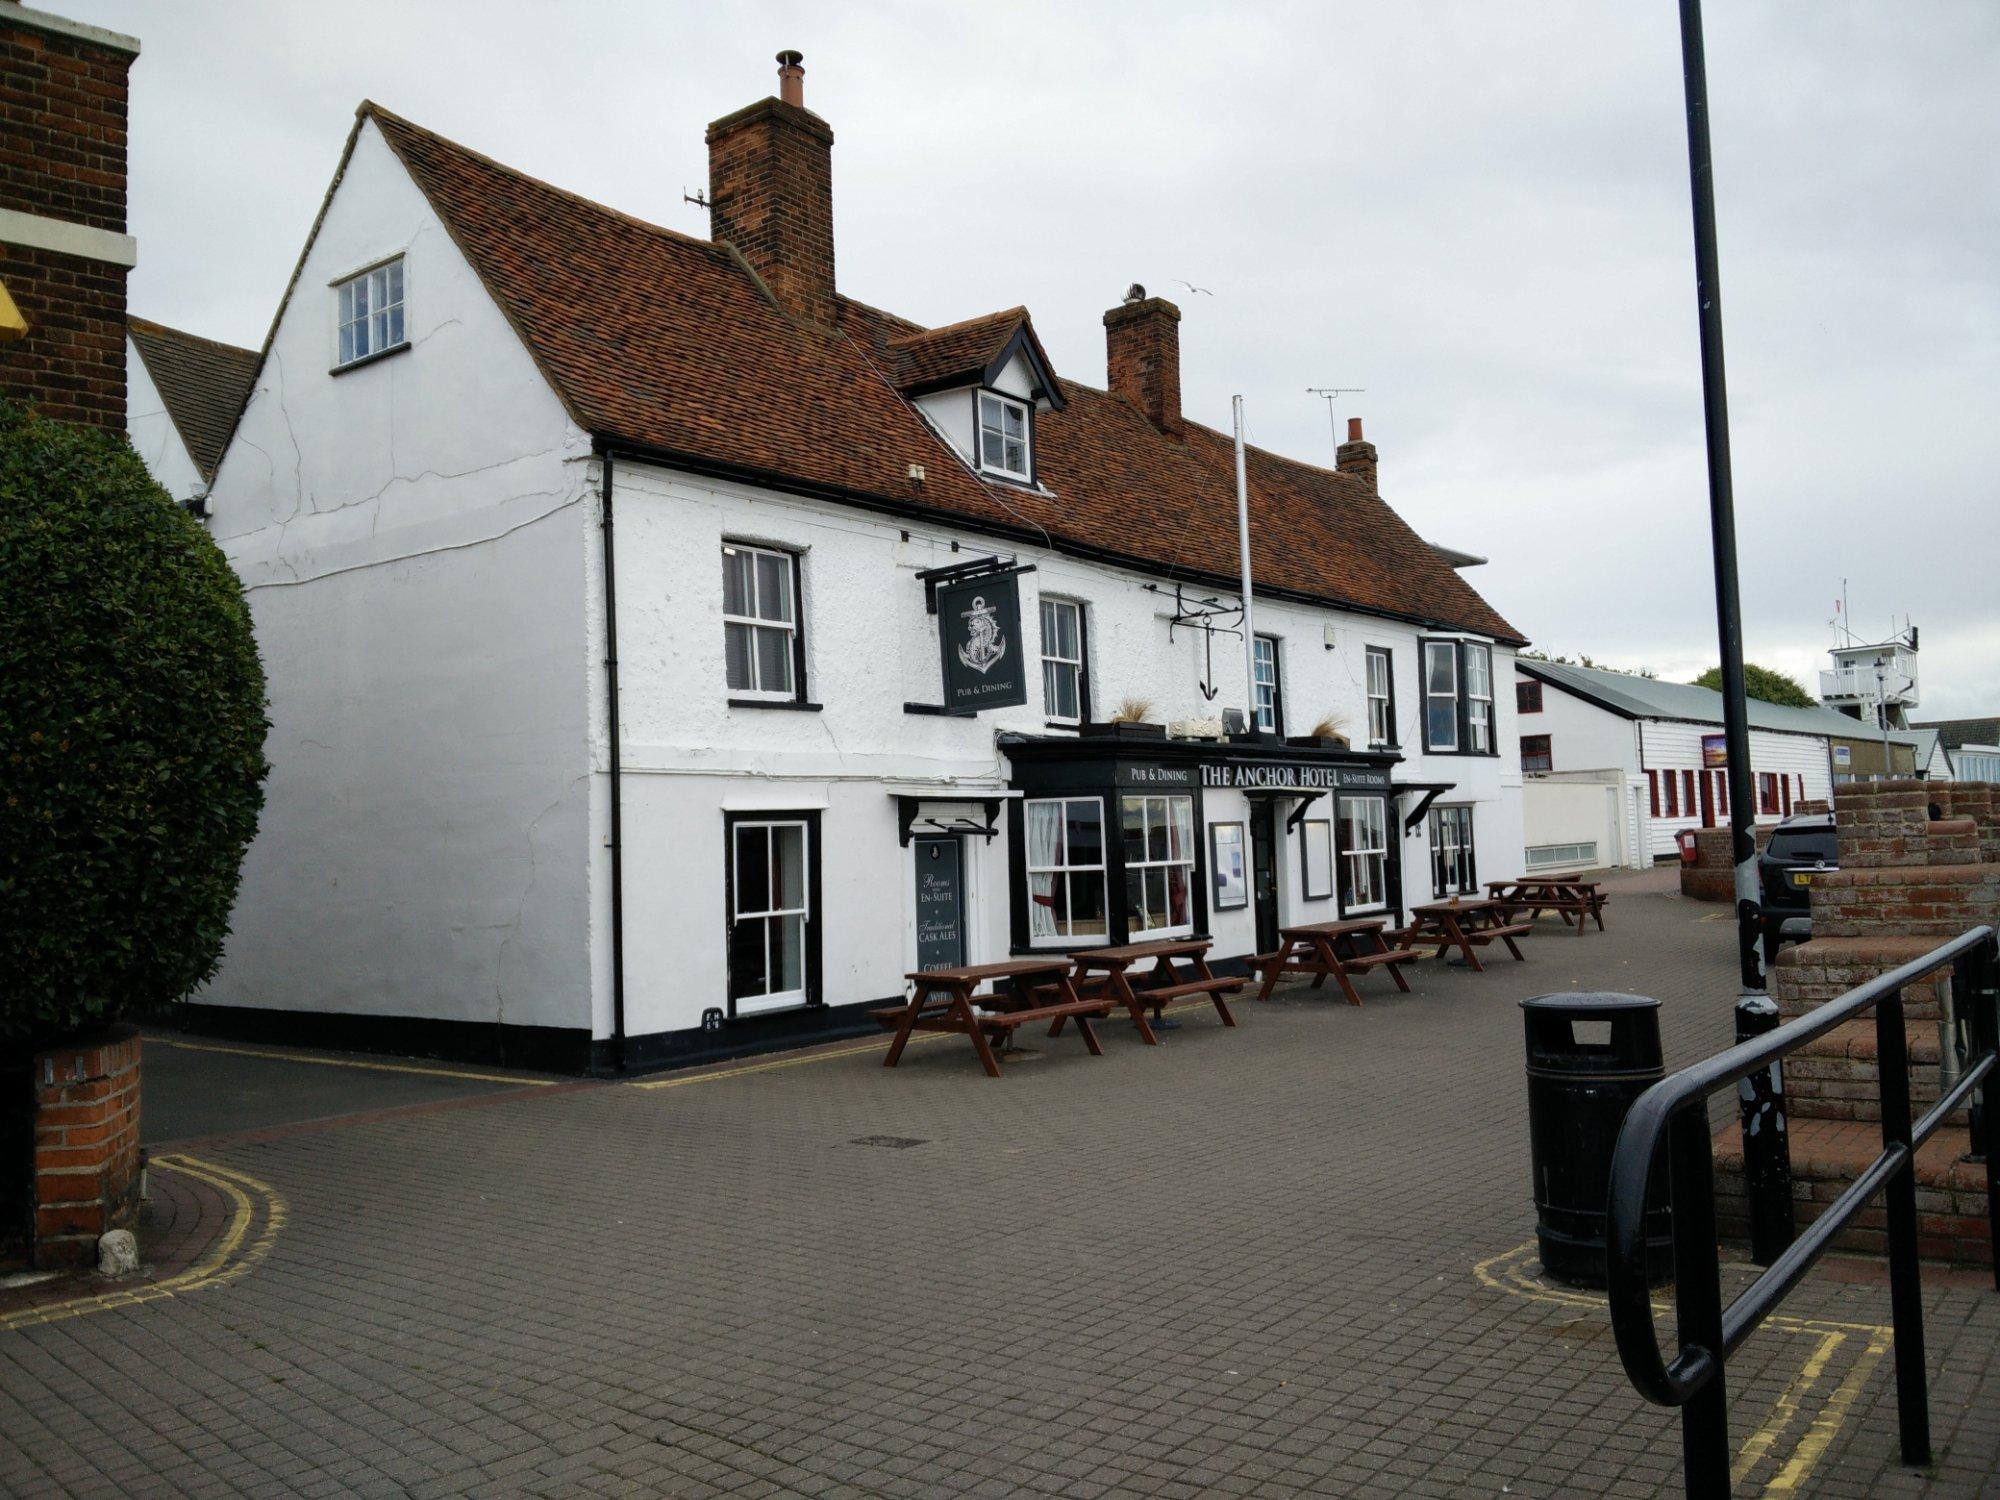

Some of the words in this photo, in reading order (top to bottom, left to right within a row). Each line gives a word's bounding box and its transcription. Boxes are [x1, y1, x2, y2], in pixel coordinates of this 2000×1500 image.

[957, 688, 972, 697] PUB
[973, 685, 980, 695] &
[981, 681, 1012, 693] DINING
[1130, 767, 1147, 781] PUB
[1148, 768, 1157, 781] &
[1157, 768, 1188, 781] DINING
[1199, 764, 1231, 786] THE
[1234, 765, 1297, 787] ANCHOR
[1299, 766, 1340, 787] HOTEL
[921, 892, 953, 903] EN-SUITE
[919, 932, 938, 943] CASK
[939, 931, 956, 941] ALES
